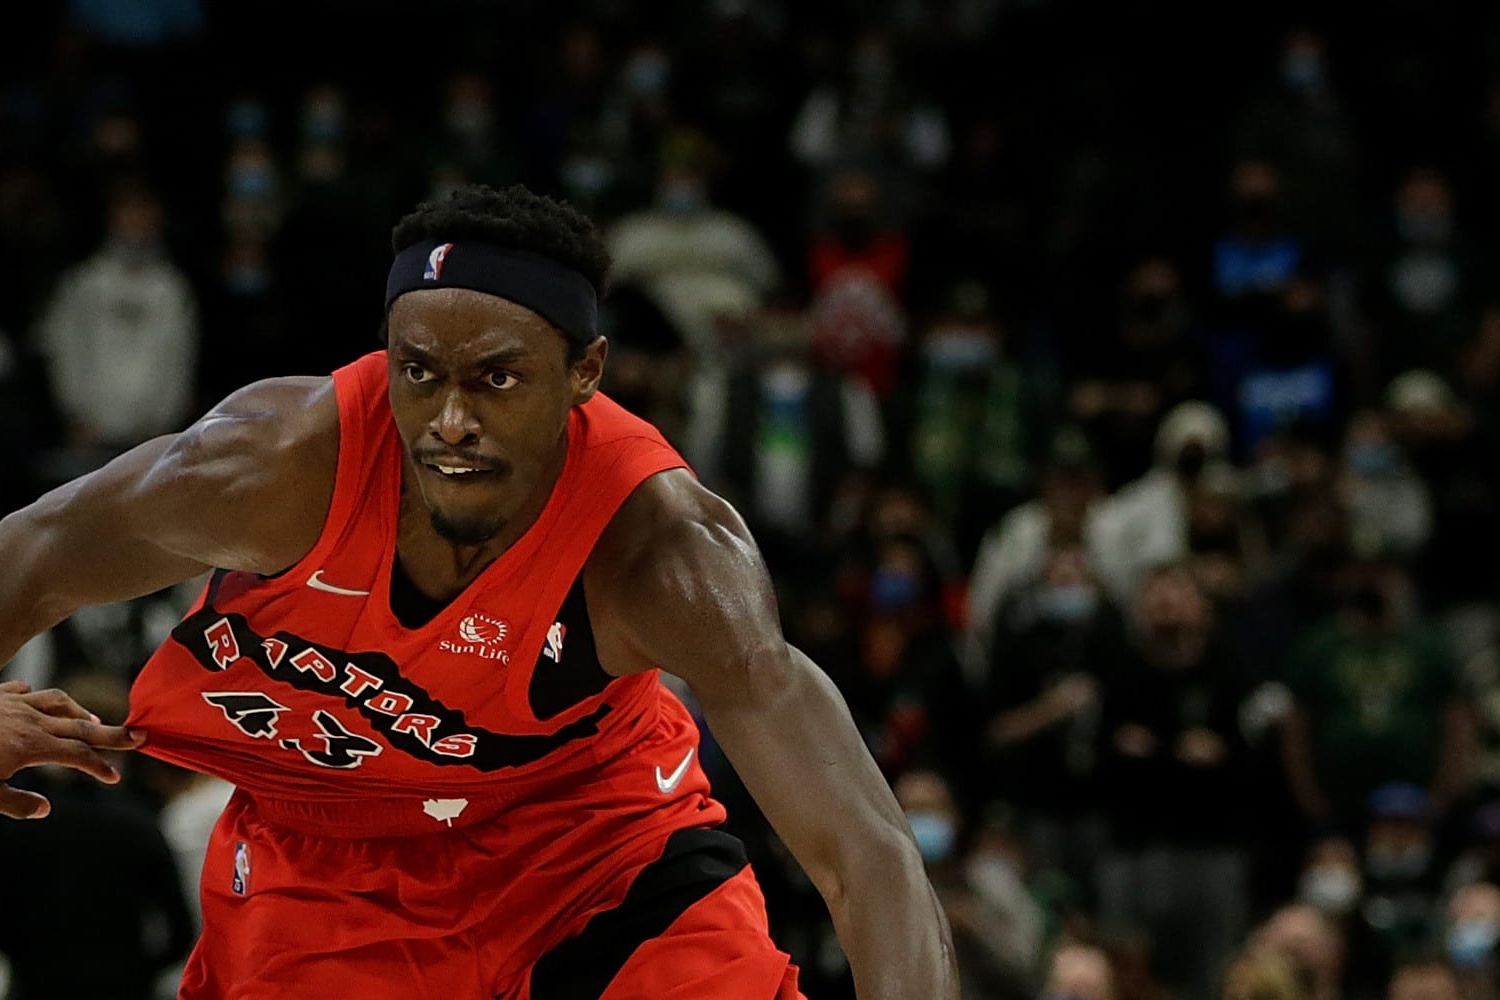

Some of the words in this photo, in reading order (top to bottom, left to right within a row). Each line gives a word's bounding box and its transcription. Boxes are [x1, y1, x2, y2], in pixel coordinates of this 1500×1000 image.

[203, 617, 478, 758] RAPTORS
[439, 640, 475, 654] Sun
[478, 645, 510, 666] Life
[201, 691, 383, 768] 43
